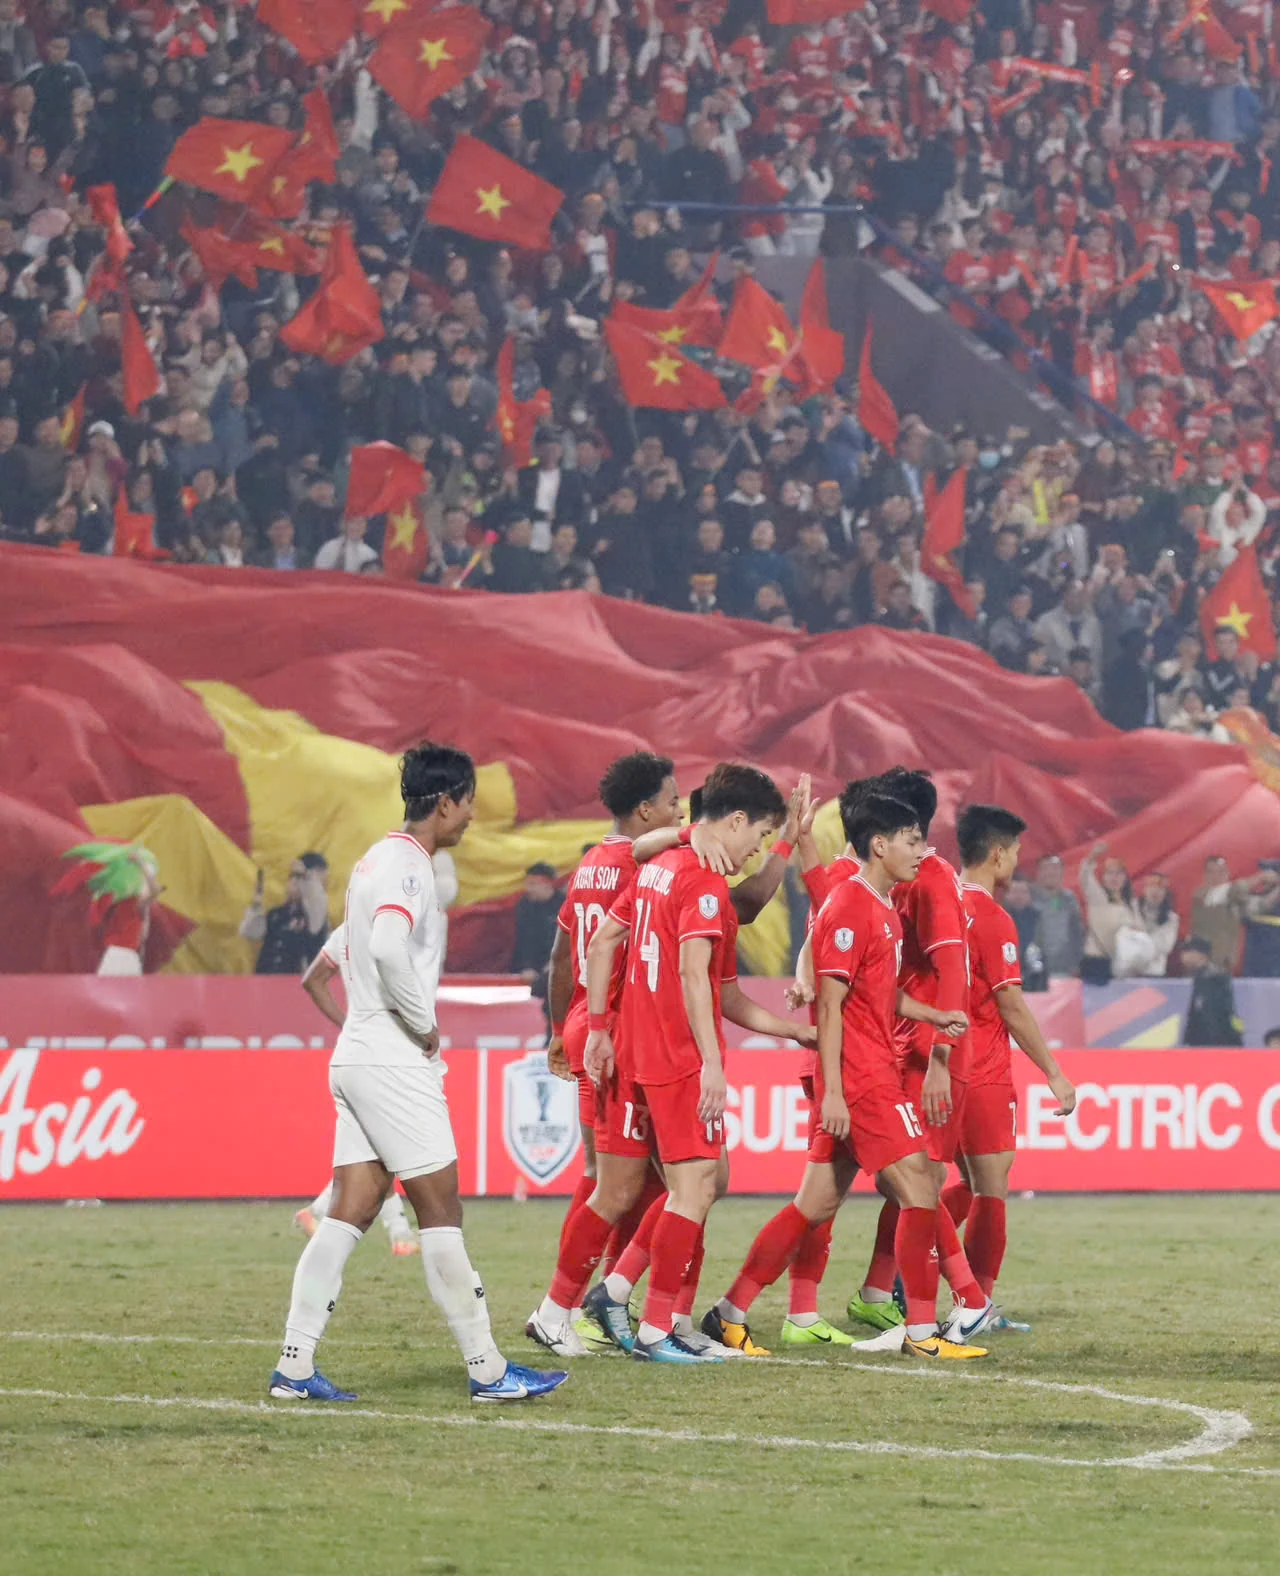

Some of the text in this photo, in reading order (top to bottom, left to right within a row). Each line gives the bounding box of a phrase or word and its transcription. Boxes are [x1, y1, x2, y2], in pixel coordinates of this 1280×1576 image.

[595, 865, 621, 891] SON
[631, 898, 661, 993] 14
[623, 1101, 650, 1141] 13
